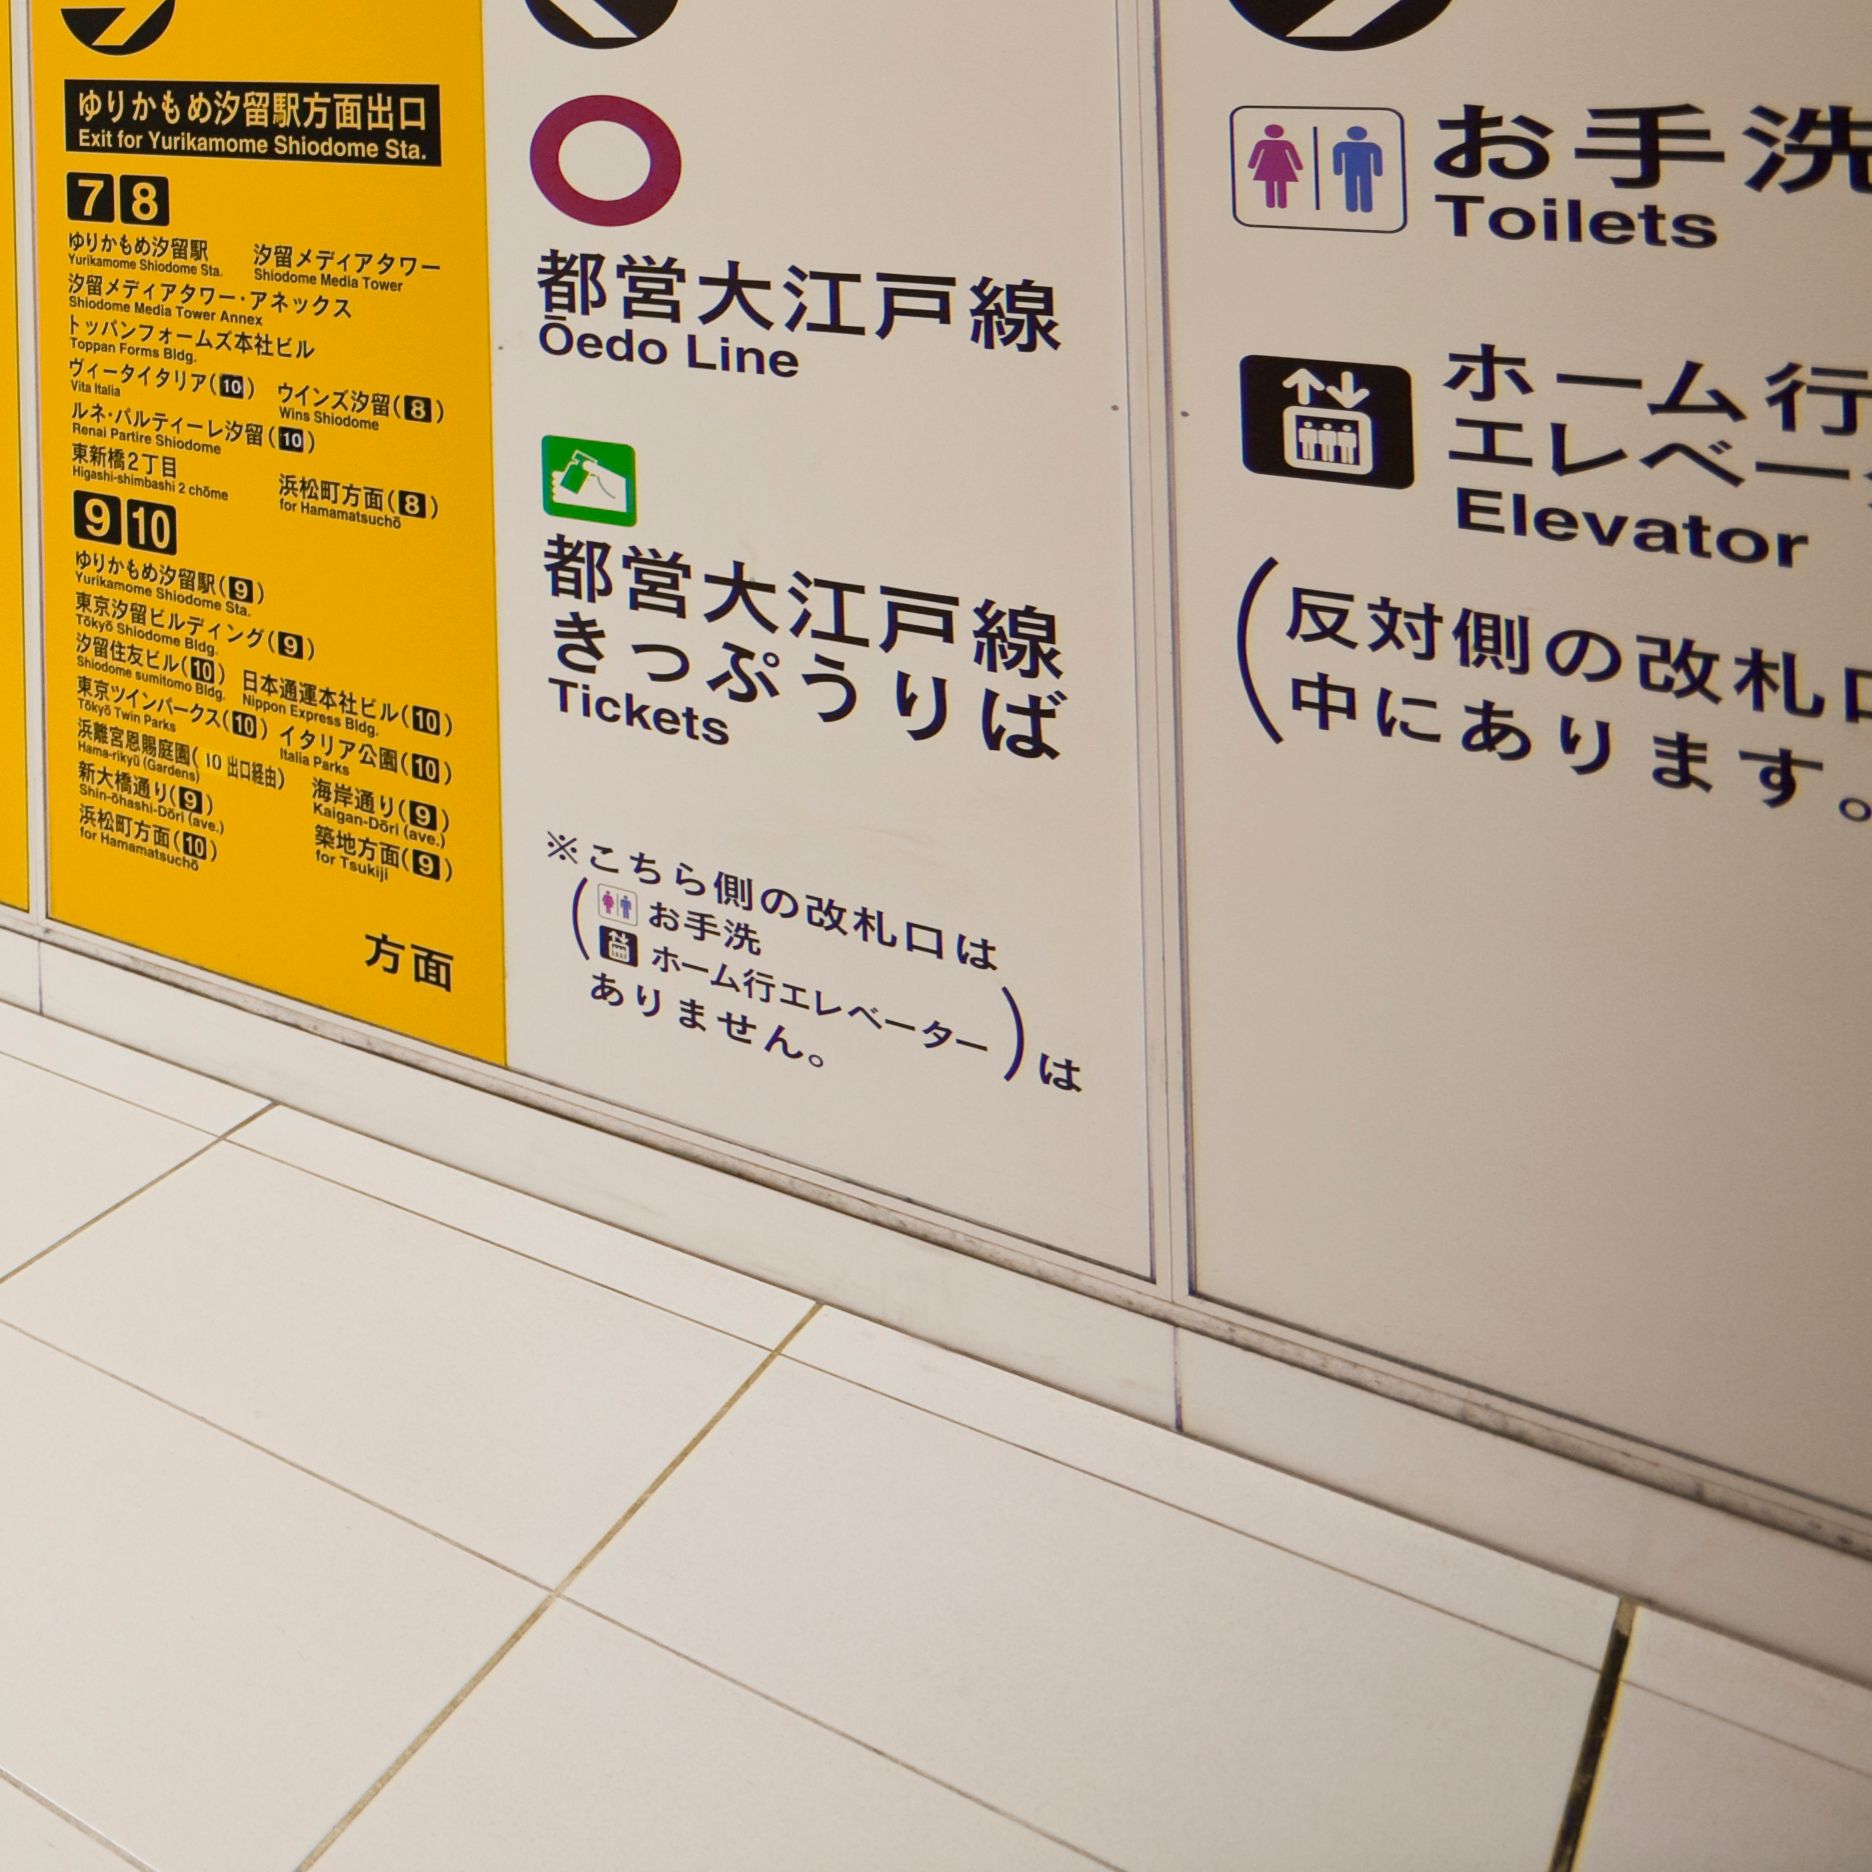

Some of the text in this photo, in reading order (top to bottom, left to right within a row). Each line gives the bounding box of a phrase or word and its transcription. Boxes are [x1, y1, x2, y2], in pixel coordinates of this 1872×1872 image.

[79, 90, 426, 131] ゆりかもめ汐留駅方面出口
[79, 128, 427, 160] Exit for Yurikamome Shiodome Sta.
[1433, 103, 1872, 194] お手洗
[77, 179, 158, 220] 7 8
[1434, 193, 1718, 249] Toilets
[69, 232, 208, 262] ゆりかもめ汐留駅
[253, 243, 440, 276] 汐留メディアタワー
[537, 248, 1062, 353] 都営大江戸線
[70, 314, 314, 360] トッパンフォームズ本社ビル
[70, 337, 197, 364] Toppan Forms Bldg.
[538, 315, 799, 378] Ōedo Line
[1443, 343, 1872, 436] ホーム行
[73, 442, 177, 479] 東新橋2丁目
[1448, 417, 1872, 511] エレベー
[84, 497, 170, 546] 9 10
[1457, 486, 1808, 569] Elevator
[544, 532, 1064, 679] 都営大江戸線
[549, 677, 729, 746] Tickets
[552, 611, 1068, 761] きっぷうりば
[1291, 671, 1872, 822] 中にあります。
[316, 850, 388, 883] for Tsukiji
[364, 932, 453, 992] 方面
[590, 972, 824, 1069] ありません。
[652, 946, 989, 1053] ホーム行エレベーター
